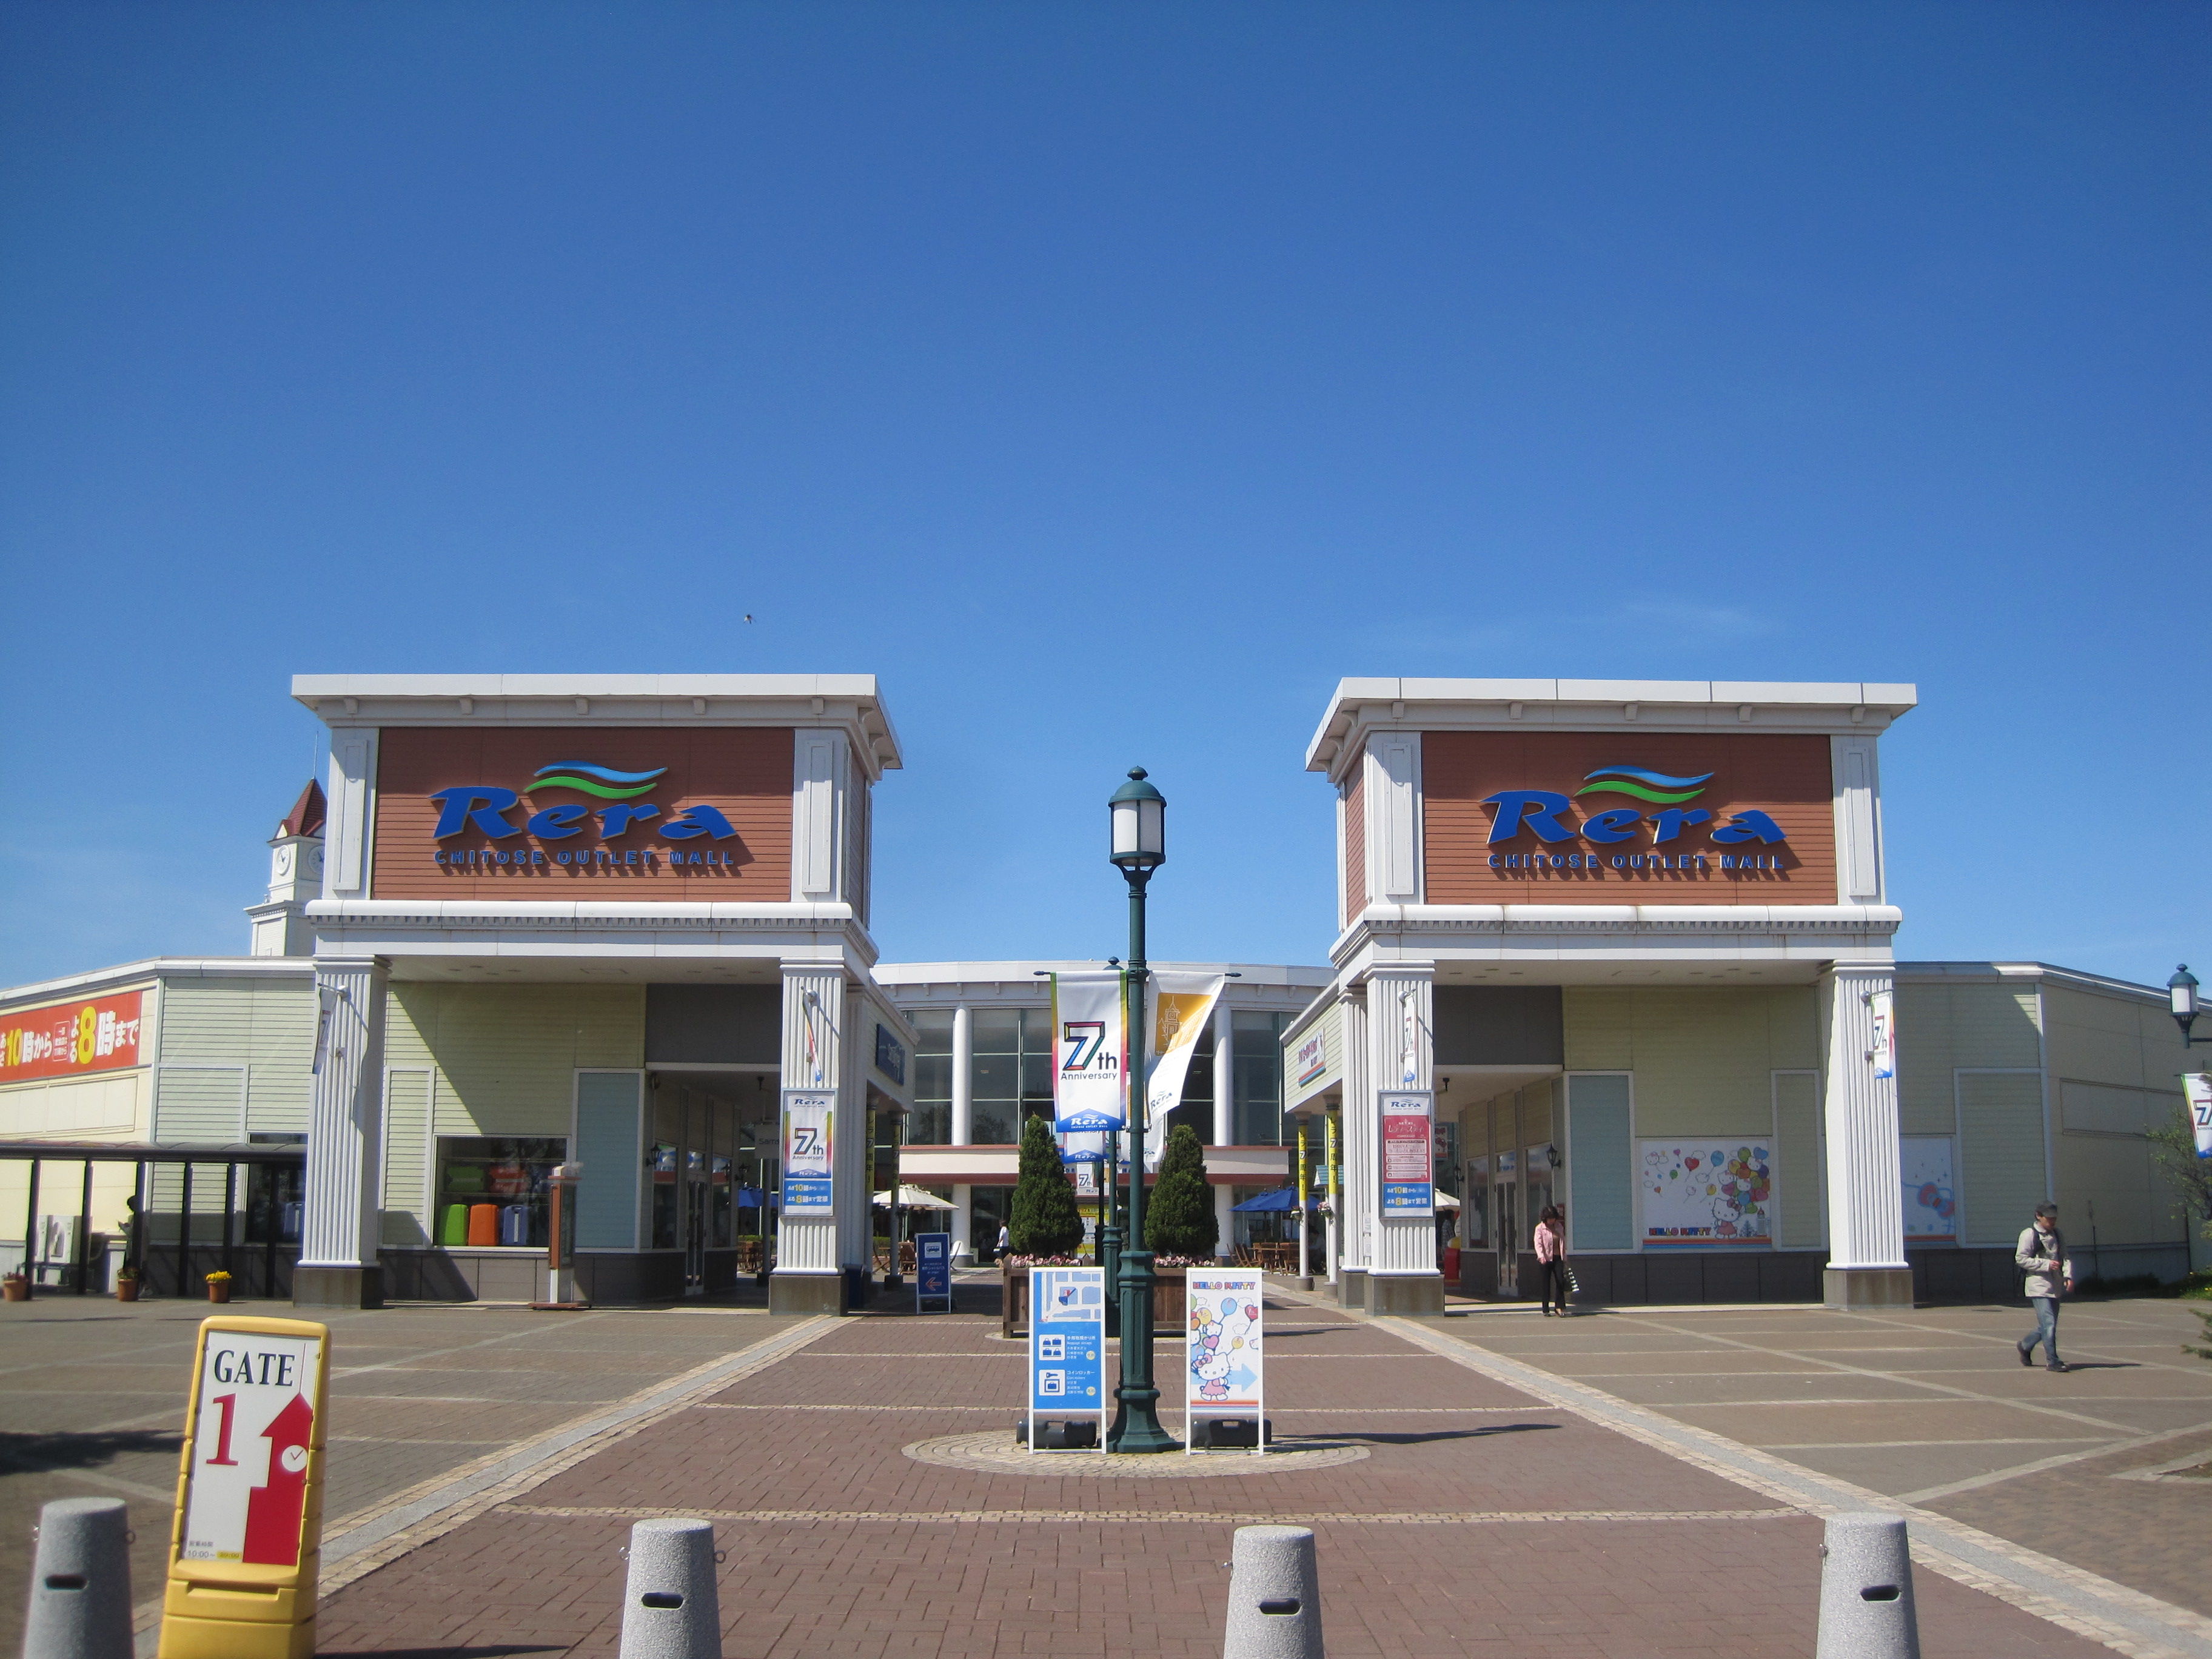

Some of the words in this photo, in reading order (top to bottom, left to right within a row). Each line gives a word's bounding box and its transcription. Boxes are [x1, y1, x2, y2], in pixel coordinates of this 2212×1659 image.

[429, 785, 737, 840] Rera
[1478, 789, 1787, 845] Rera
[434, 850, 545, 865] CHITOSE
[557, 850, 652, 865] OUTLET
[669, 850, 735, 865] MALL
[1487, 853, 1598, 870] CHITOSE
[1612, 853, 1706, 870] OUTLET
[1719, 853, 1786, 870] MALL
[1062, 1021, 1117, 1071] 7th
[1061, 1071, 1118, 1081] Anniversary
[793, 1127, 823, 1155] 7th
[1193, 1281, 1223, 1290] HELLO
[1224, 1281, 1256, 1290] KITTY
[214, 1349, 296, 1387] GATE
[206, 1392, 239, 1466] 1
